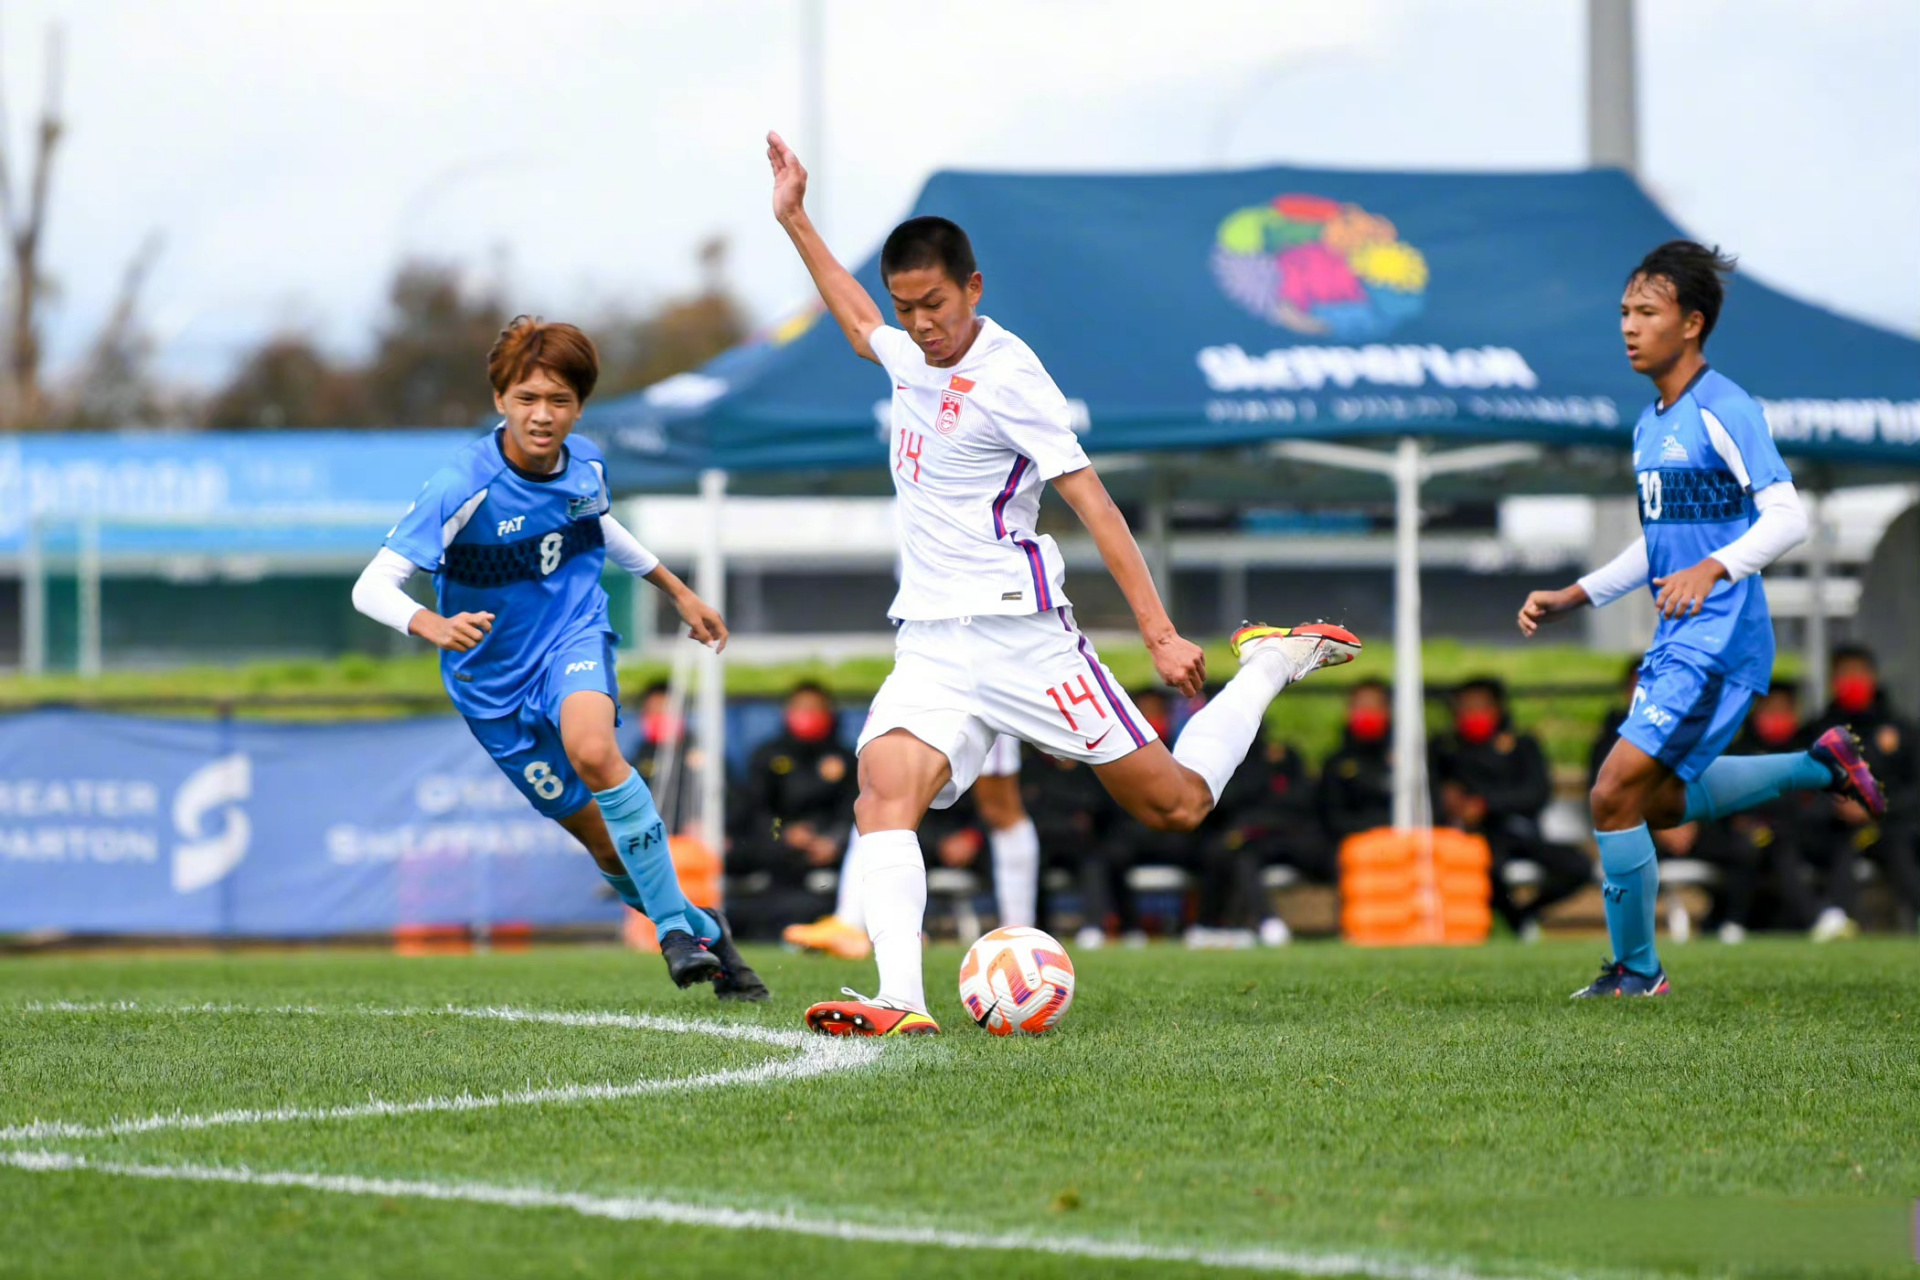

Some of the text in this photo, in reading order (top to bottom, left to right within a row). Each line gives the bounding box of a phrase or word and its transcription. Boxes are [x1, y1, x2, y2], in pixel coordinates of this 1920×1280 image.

[896, 428, 923, 483] 14
[1638, 470, 1662, 520] 10
[498, 515, 526, 537] FAT
[540, 532, 564, 576] 8
[565, 660, 598, 675] FAT
[1046, 674, 1107, 732] 14
[524, 761, 564, 800] 8
[0, 827, 159, 863] ARTON
[628, 822, 662, 855] FAT
